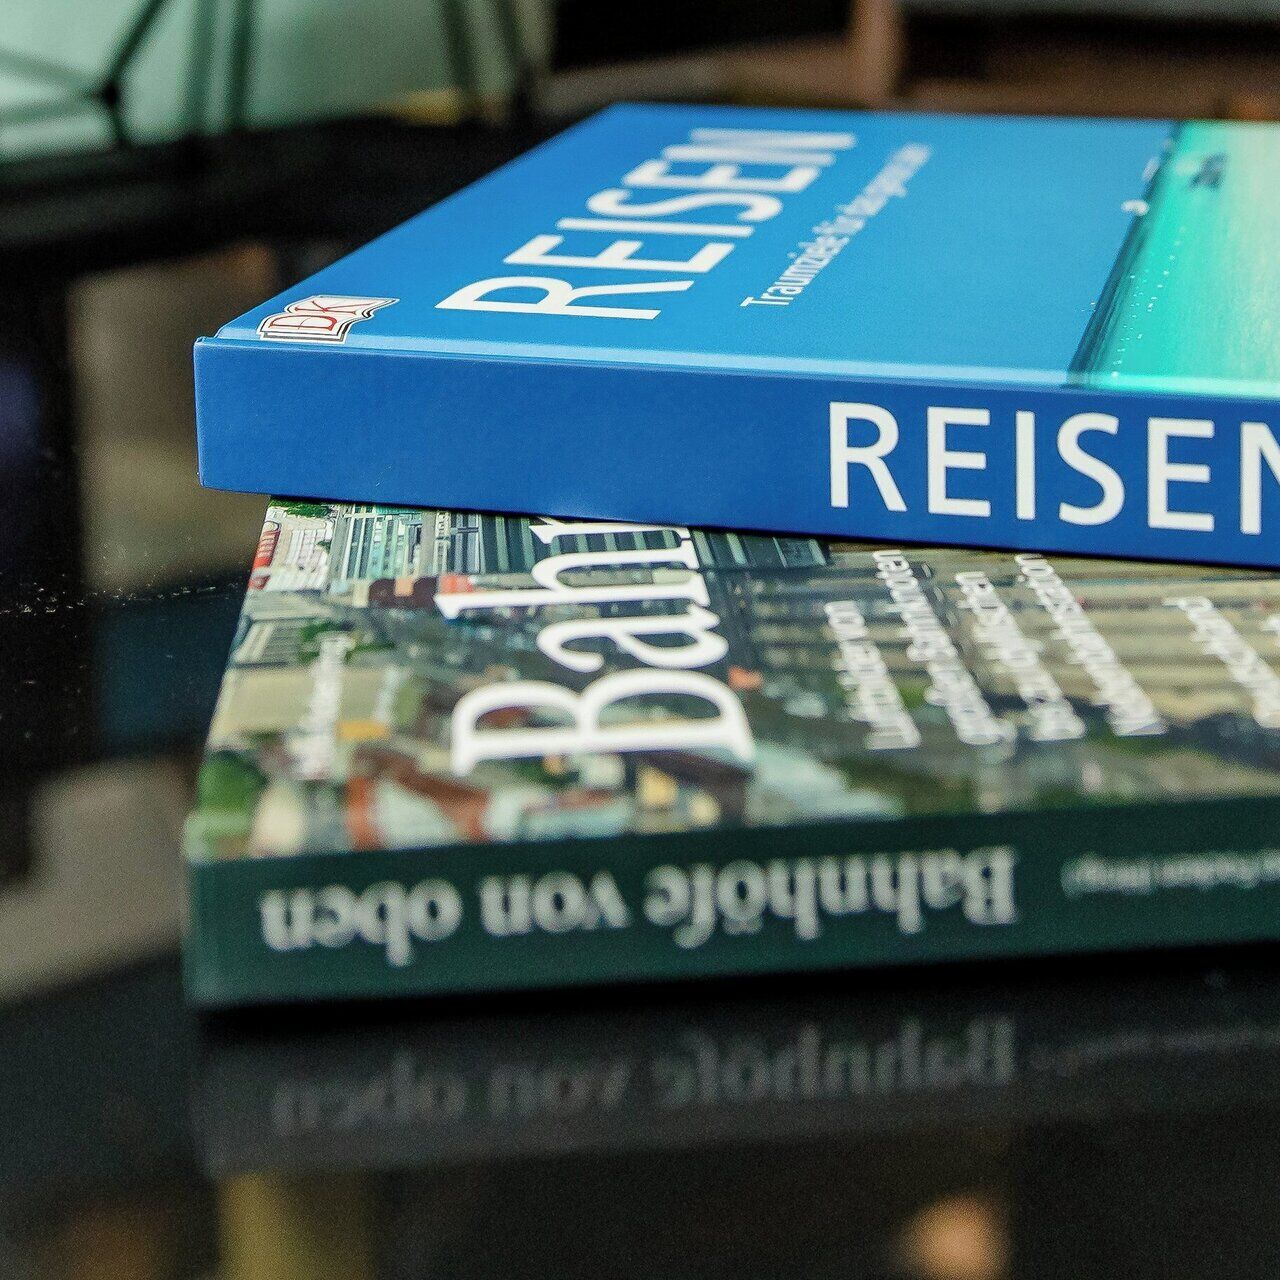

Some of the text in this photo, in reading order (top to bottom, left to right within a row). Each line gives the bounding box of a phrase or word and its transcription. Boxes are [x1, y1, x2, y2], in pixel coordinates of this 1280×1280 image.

[434, 127, 858, 320] REISEN
[258, 846, 1017, 967] Bahnhöfe von oben
